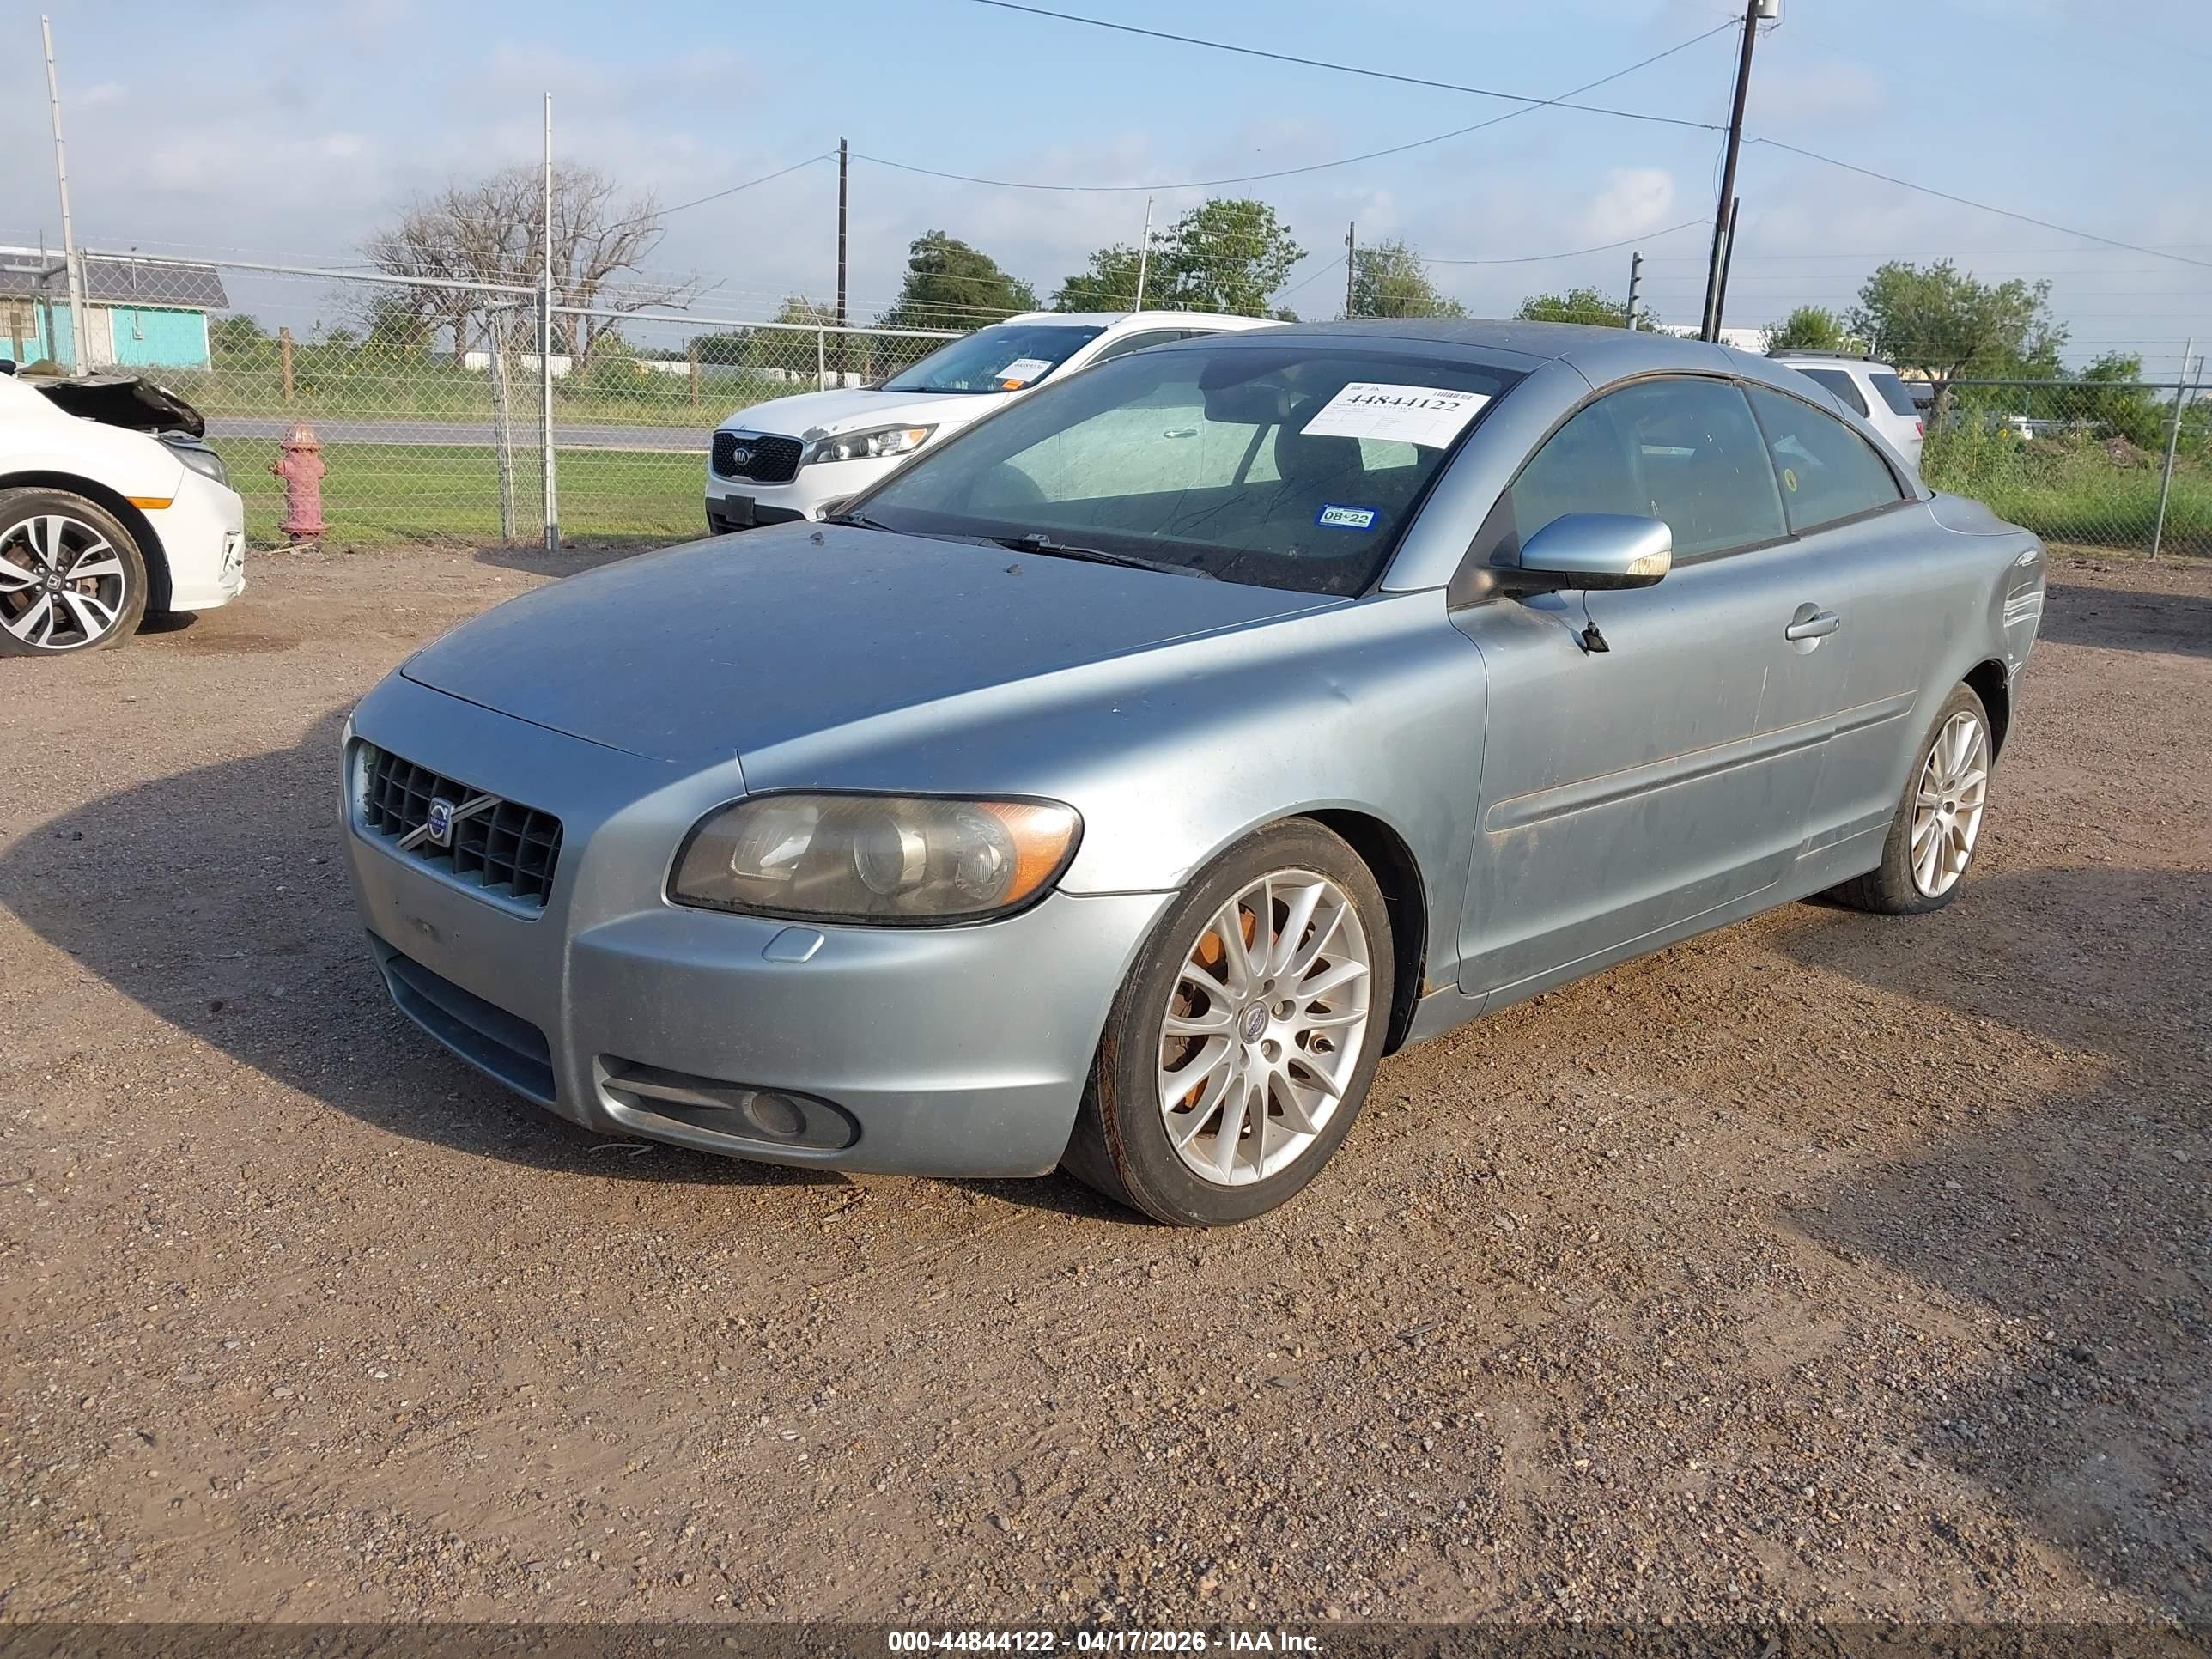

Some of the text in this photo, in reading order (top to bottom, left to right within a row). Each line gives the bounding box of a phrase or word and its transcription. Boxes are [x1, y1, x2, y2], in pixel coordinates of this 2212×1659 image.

[1346, 394, 1461, 412] 44844122
[734, 452, 745, 462] KIA
[1324, 511, 1369, 524] 08 22
